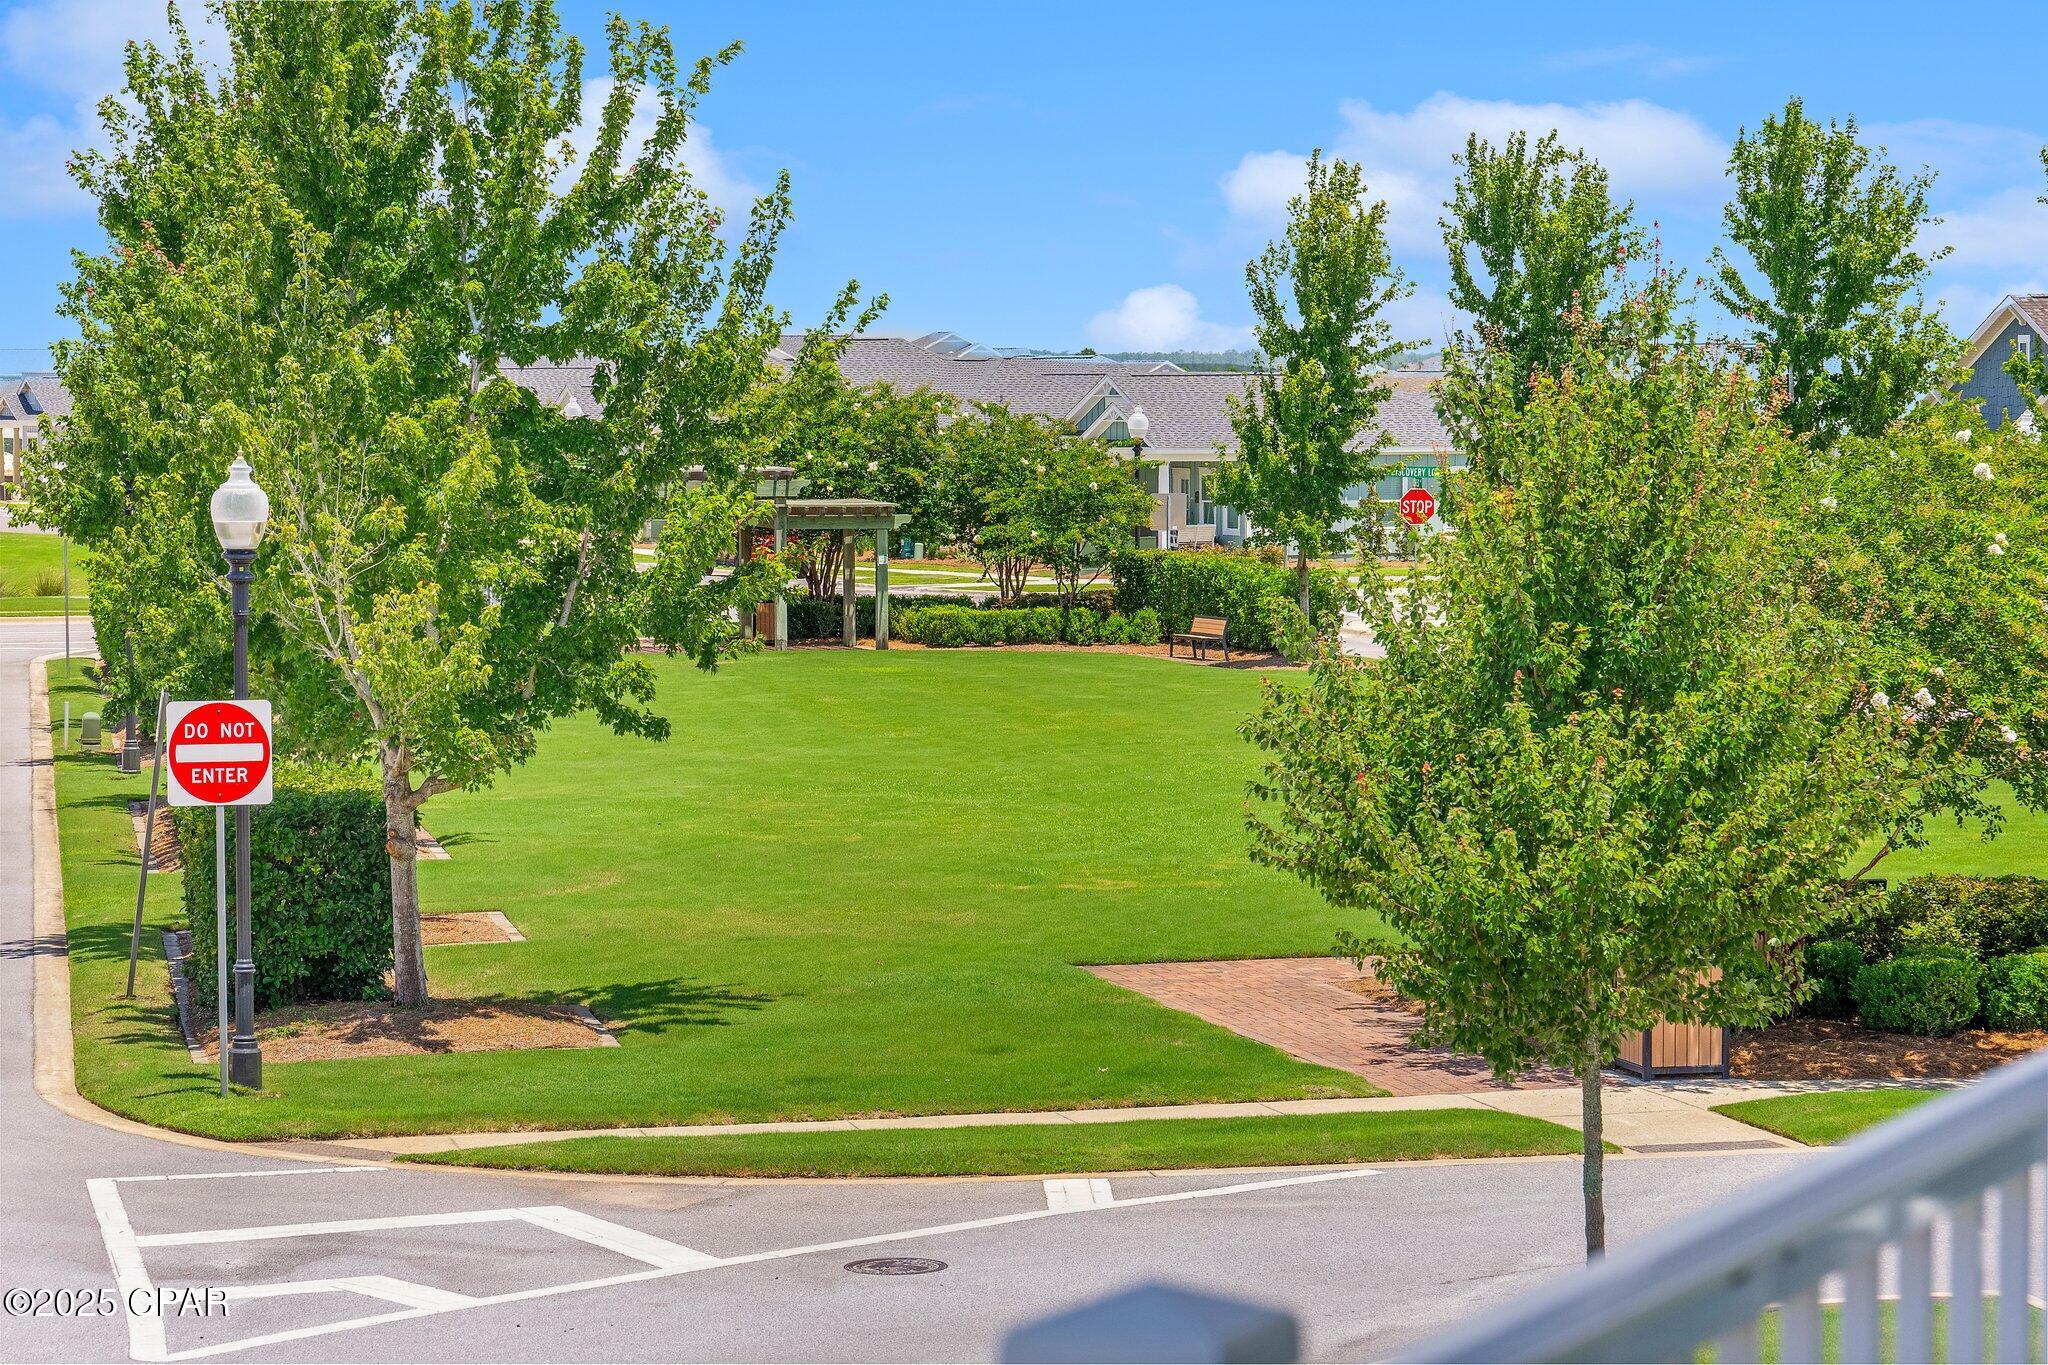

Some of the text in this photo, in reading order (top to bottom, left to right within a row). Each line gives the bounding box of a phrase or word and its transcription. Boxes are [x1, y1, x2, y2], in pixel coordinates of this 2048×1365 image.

[1402, 500, 1433, 514] STOP
[184, 722, 255, 739] DO NOT
[191, 767, 248, 784] ENTER
